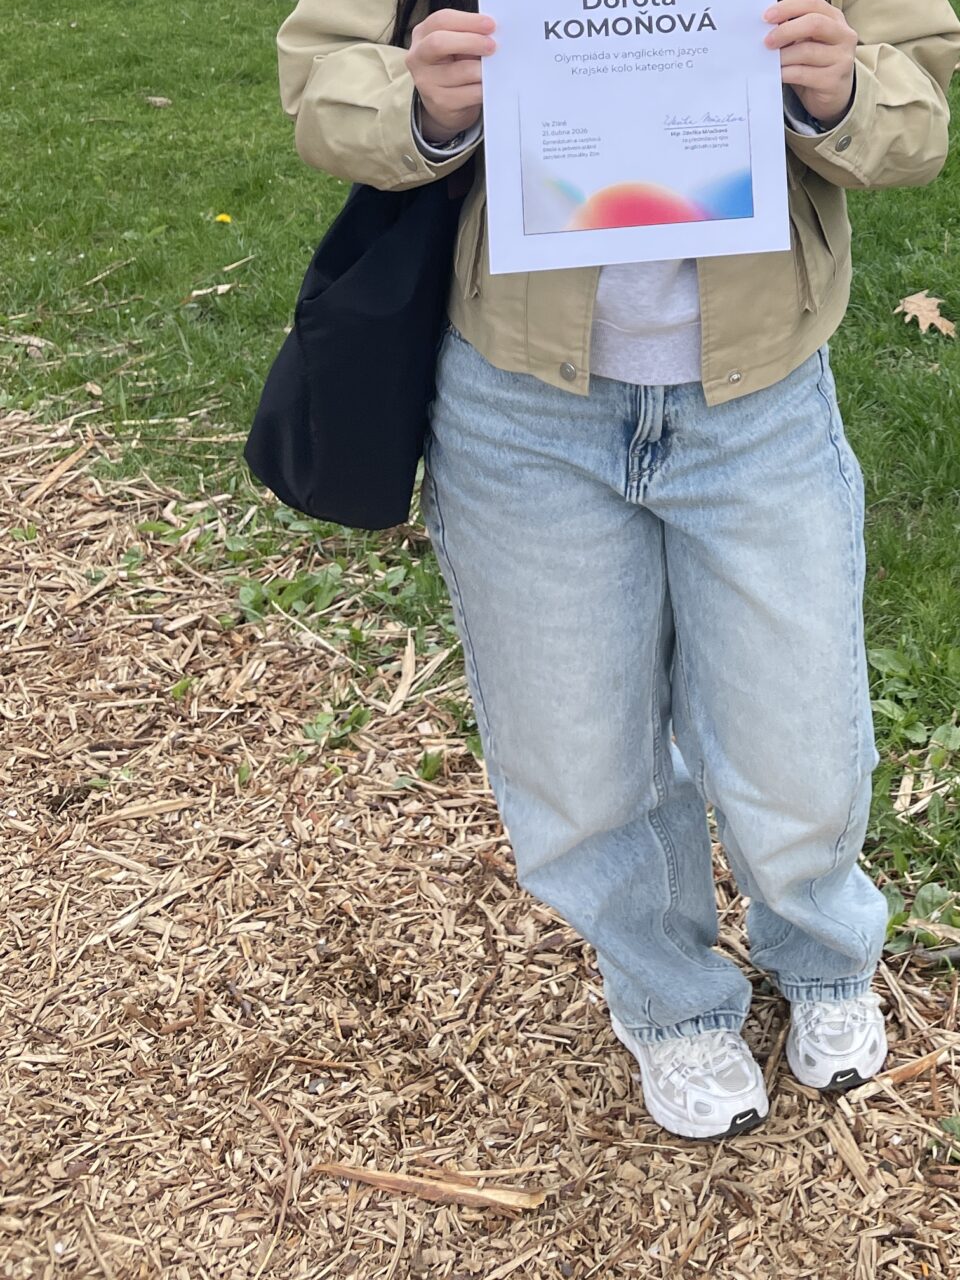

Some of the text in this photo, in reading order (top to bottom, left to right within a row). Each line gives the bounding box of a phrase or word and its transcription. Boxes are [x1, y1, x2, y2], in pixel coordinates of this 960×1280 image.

[544, 7, 717, 40] KOMOŇOVÁ
[554, 45, 709, 64] Olympiáda v anglickém jazyce
[571, 64, 609, 77] Krajské
[611, 62, 633, 73] kolo
[635, 60, 684, 73] kategorie
